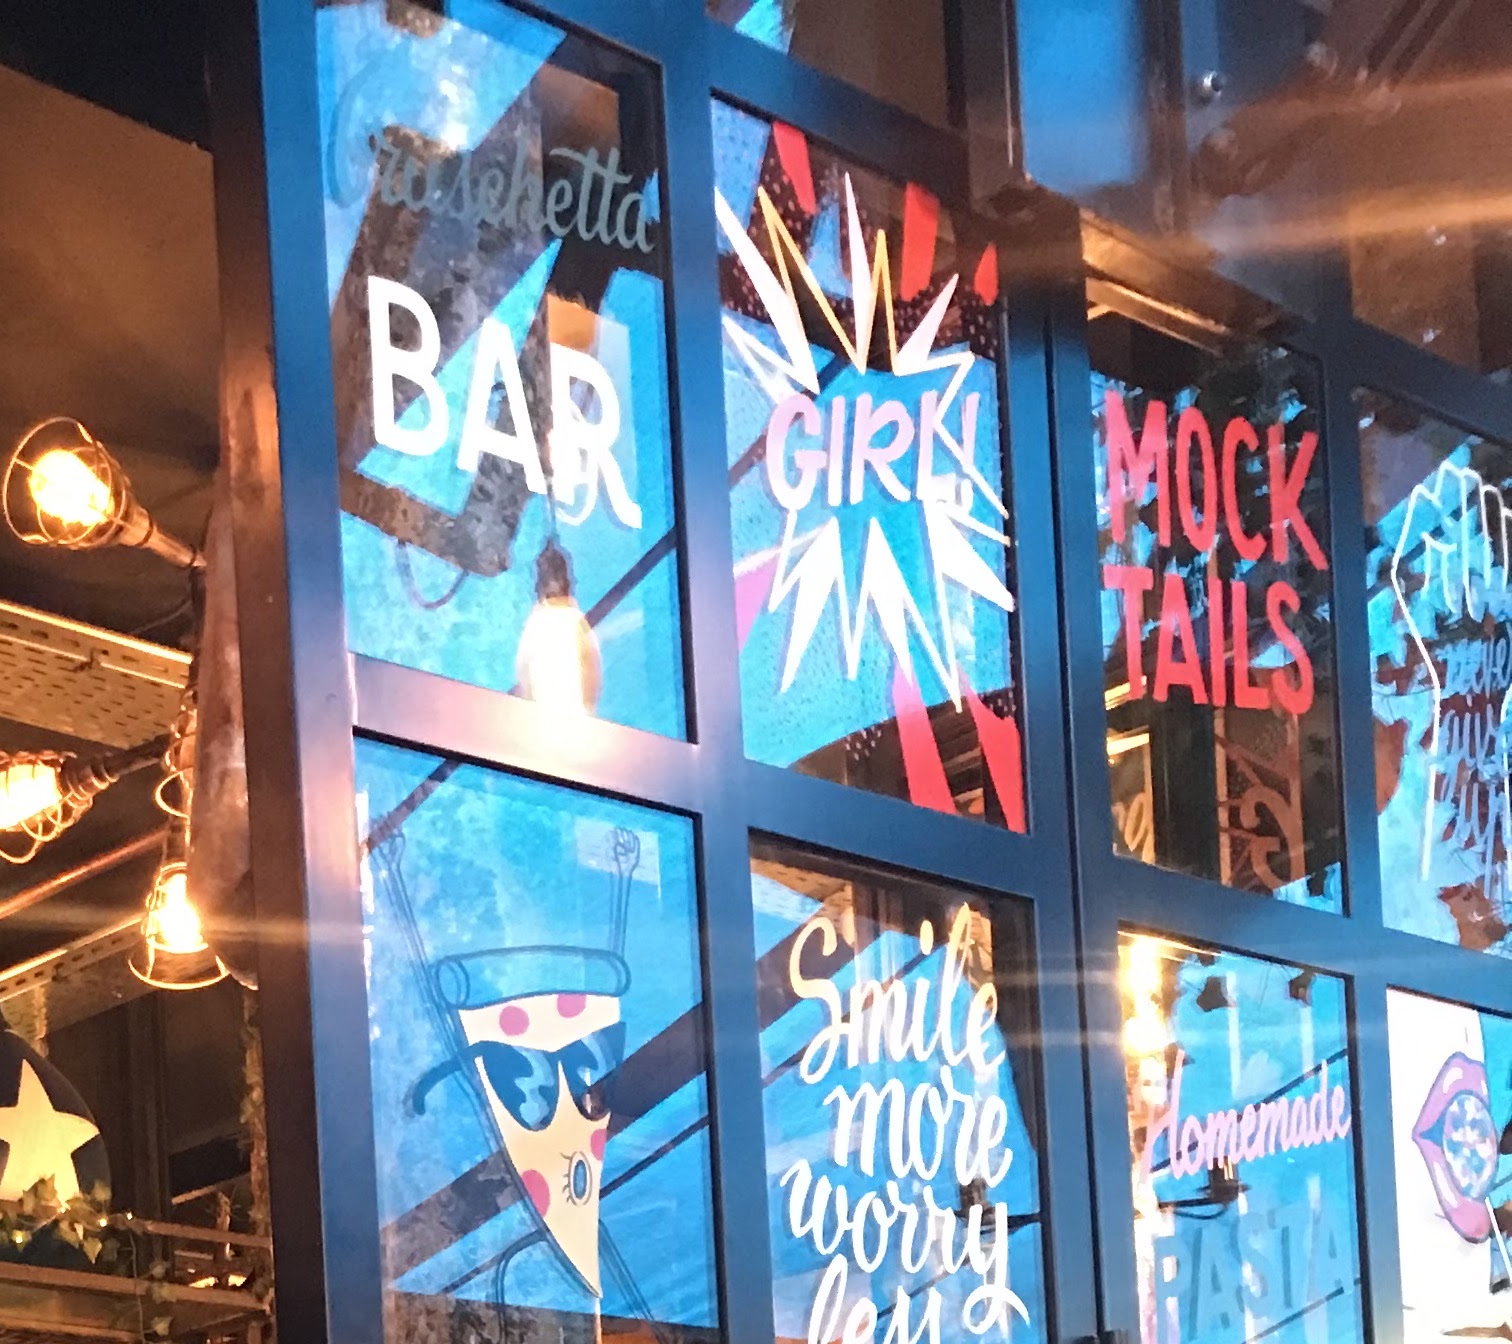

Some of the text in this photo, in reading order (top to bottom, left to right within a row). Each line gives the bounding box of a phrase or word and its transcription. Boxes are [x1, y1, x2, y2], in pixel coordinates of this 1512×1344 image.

[368, 275, 642, 529] BAR
[1104, 388, 1328, 571] MOCK
[1103, 564, 1314, 714] TAILS
[790, 901, 1006, 1085] Smile
[822, 1064, 1014, 1188] more
[1141, 1048, 1352, 1182] Homemade
[779, 1158, 1030, 1335] worry
